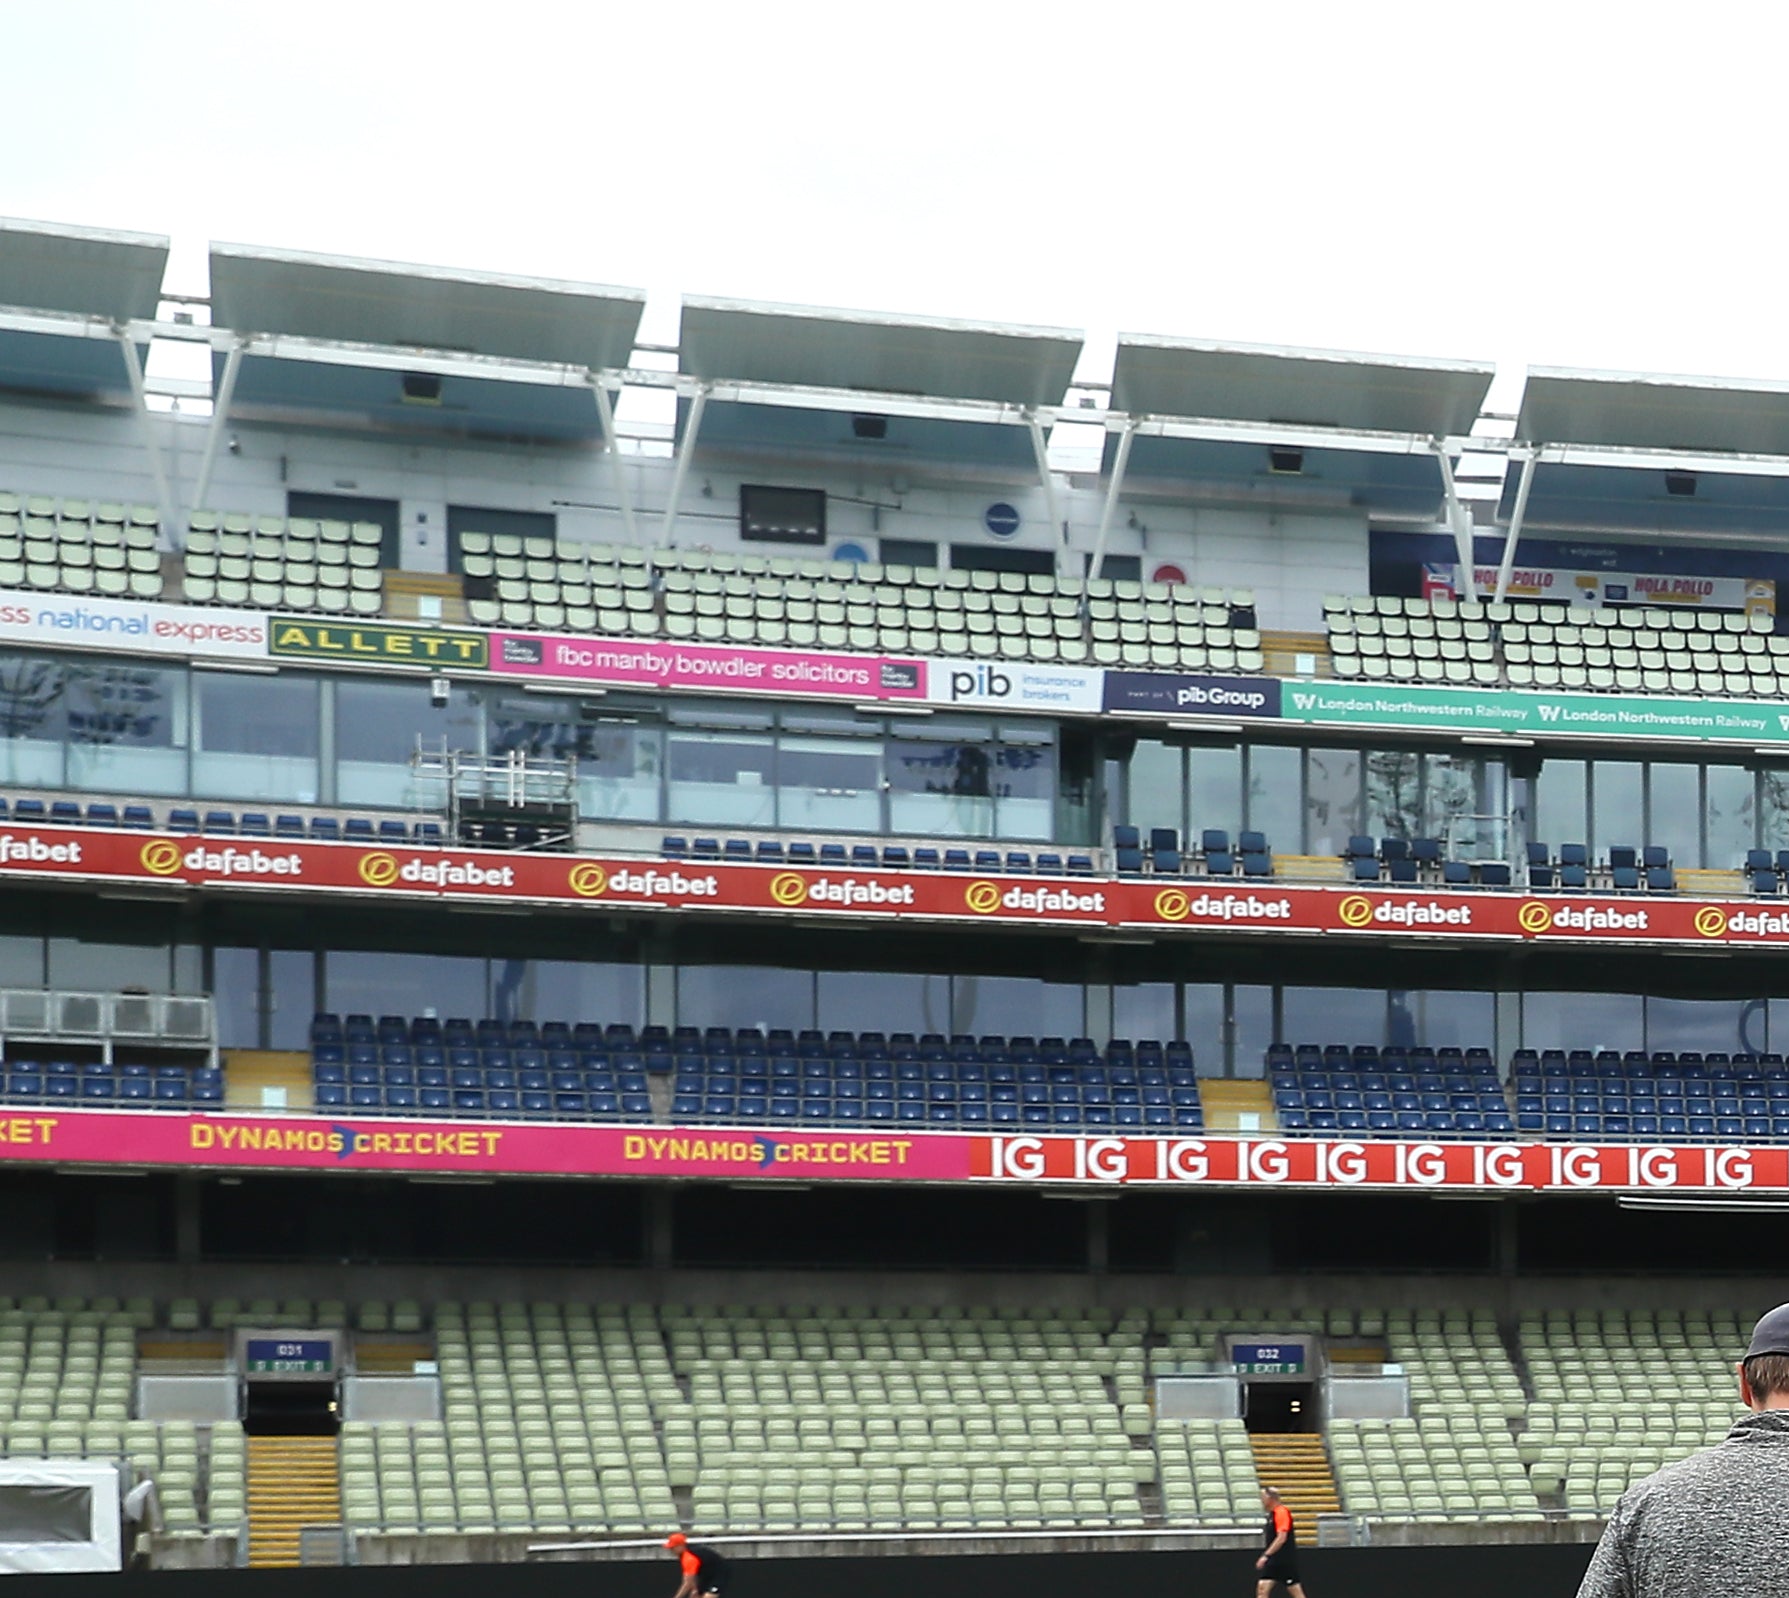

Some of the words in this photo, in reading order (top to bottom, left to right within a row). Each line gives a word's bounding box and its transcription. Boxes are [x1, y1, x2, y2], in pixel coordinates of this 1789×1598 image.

[1512, 571, 1553, 587] POLLO
[1635, 577, 1668, 593] HOLA
[1674, 580, 1713, 595] POLLO
[38, 607, 149, 635] national
[155, 619, 264, 643] express
[277, 627, 480, 659] ALLETT
[556, 645, 593, 667] fbc
[597, 650, 673, 676] manby
[677, 655, 766, 680] bowdler
[772, 663, 870, 686] solicitors
[1022, 673, 1087, 689] insurance
[951, 665, 1012, 702] pib
[1022, 687, 1071, 704] brokers
[1318, 697, 1373, 713] London
[1376, 701, 1473, 717] Northwestern
[1476, 705, 1528, 722] Railway
[1562, 707, 1616, 723] London
[1618, 711, 1713, 727] Northwestern
[1716, 714, 1767, 731] Railway
[0, 834, 82, 863] fabet
[184, 845, 301, 875] dafabet
[401, 857, 513, 888] dafabet
[609, 869, 717, 896] dafabet
[808, 878, 914, 904] dafabet
[1003, 887, 1105, 912] dafabet
[1191, 894, 1291, 919] dafabet
[1374, 900, 1471, 926] dafabet
[1553, 905, 1648, 931] dafabet
[190, 1123, 344, 1153] DYNAMOS
[353, 1132, 502, 1156] CRICKET
[624, 1135, 765, 1162] DYNAMOS
[774, 1140, 912, 1165] CRICKET
[991, 1137, 1046, 1179] IG
[1075, 1138, 1128, 1180] IG
[1157, 1140, 1209, 1181] IG
[1238, 1141, 1289, 1182] IG
[1316, 1143, 1367, 1183] IG
[1396, 1143, 1446, 1184] IG
[1473, 1145, 1524, 1186] IG
[1551, 1146, 1601, 1186] IG
[1628, 1147, 1677, 1187] IG
[1705, 1148, 1753, 1187] IG
